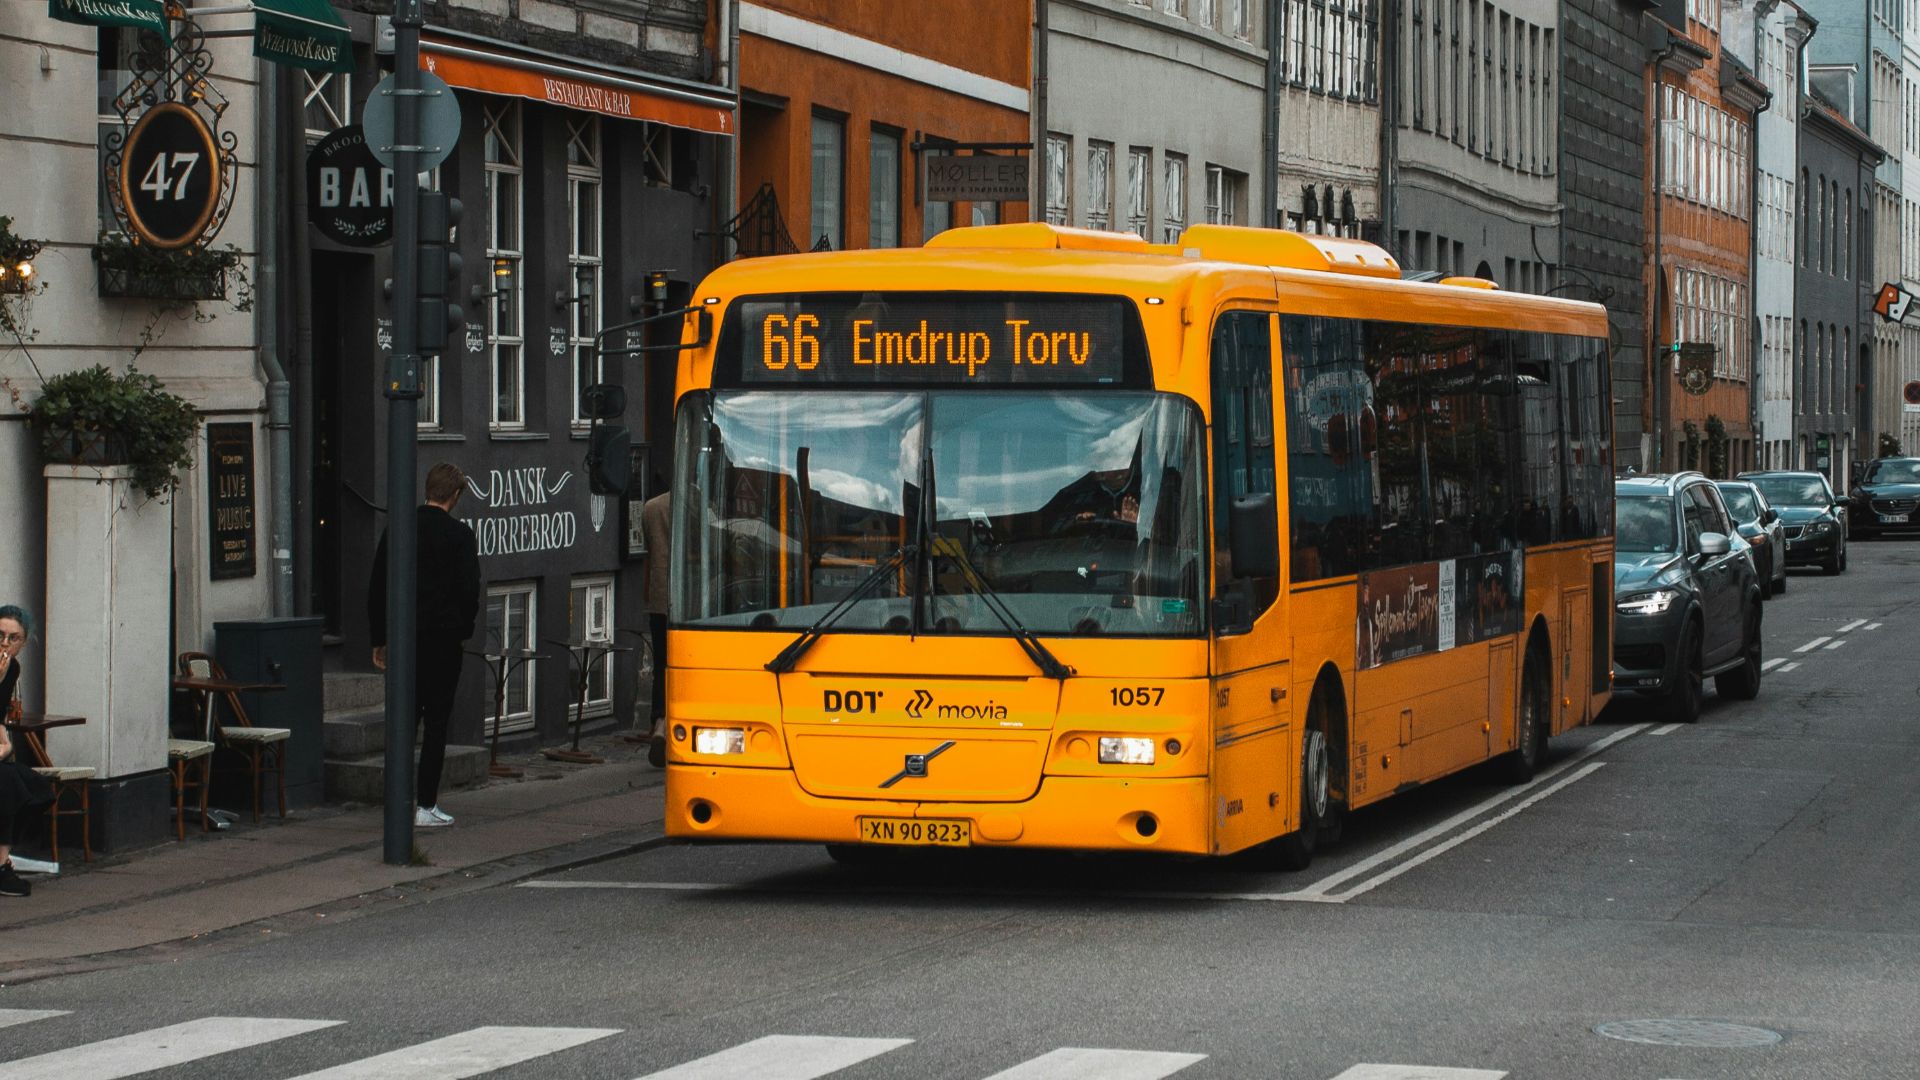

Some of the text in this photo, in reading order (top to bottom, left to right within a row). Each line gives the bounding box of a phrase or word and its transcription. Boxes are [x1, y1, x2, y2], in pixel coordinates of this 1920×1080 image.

[543, 78, 632, 116] RESTAURANT & BAR
[323, 134, 362, 157] BROO
[140, 151, 200, 202] 47
[929, 164, 1027, 182] MØLLER
[320, 167, 394, 207] BAR
[763, 314, 1090, 377] 66 Emdrup Torv
[220, 474, 246, 498] LIVE
[489, 467, 548, 508] DANSK
[217, 506, 252, 531] MUSIC
[460, 511, 577, 556] MØRREBRØD
[824, 690, 884, 714] DOT
[1110, 687, 1165, 707] 1057
[1216, 688, 1230, 708] 1057
[938, 700, 1008, 719] movia
[870, 822, 962, 842] XN 90 823
